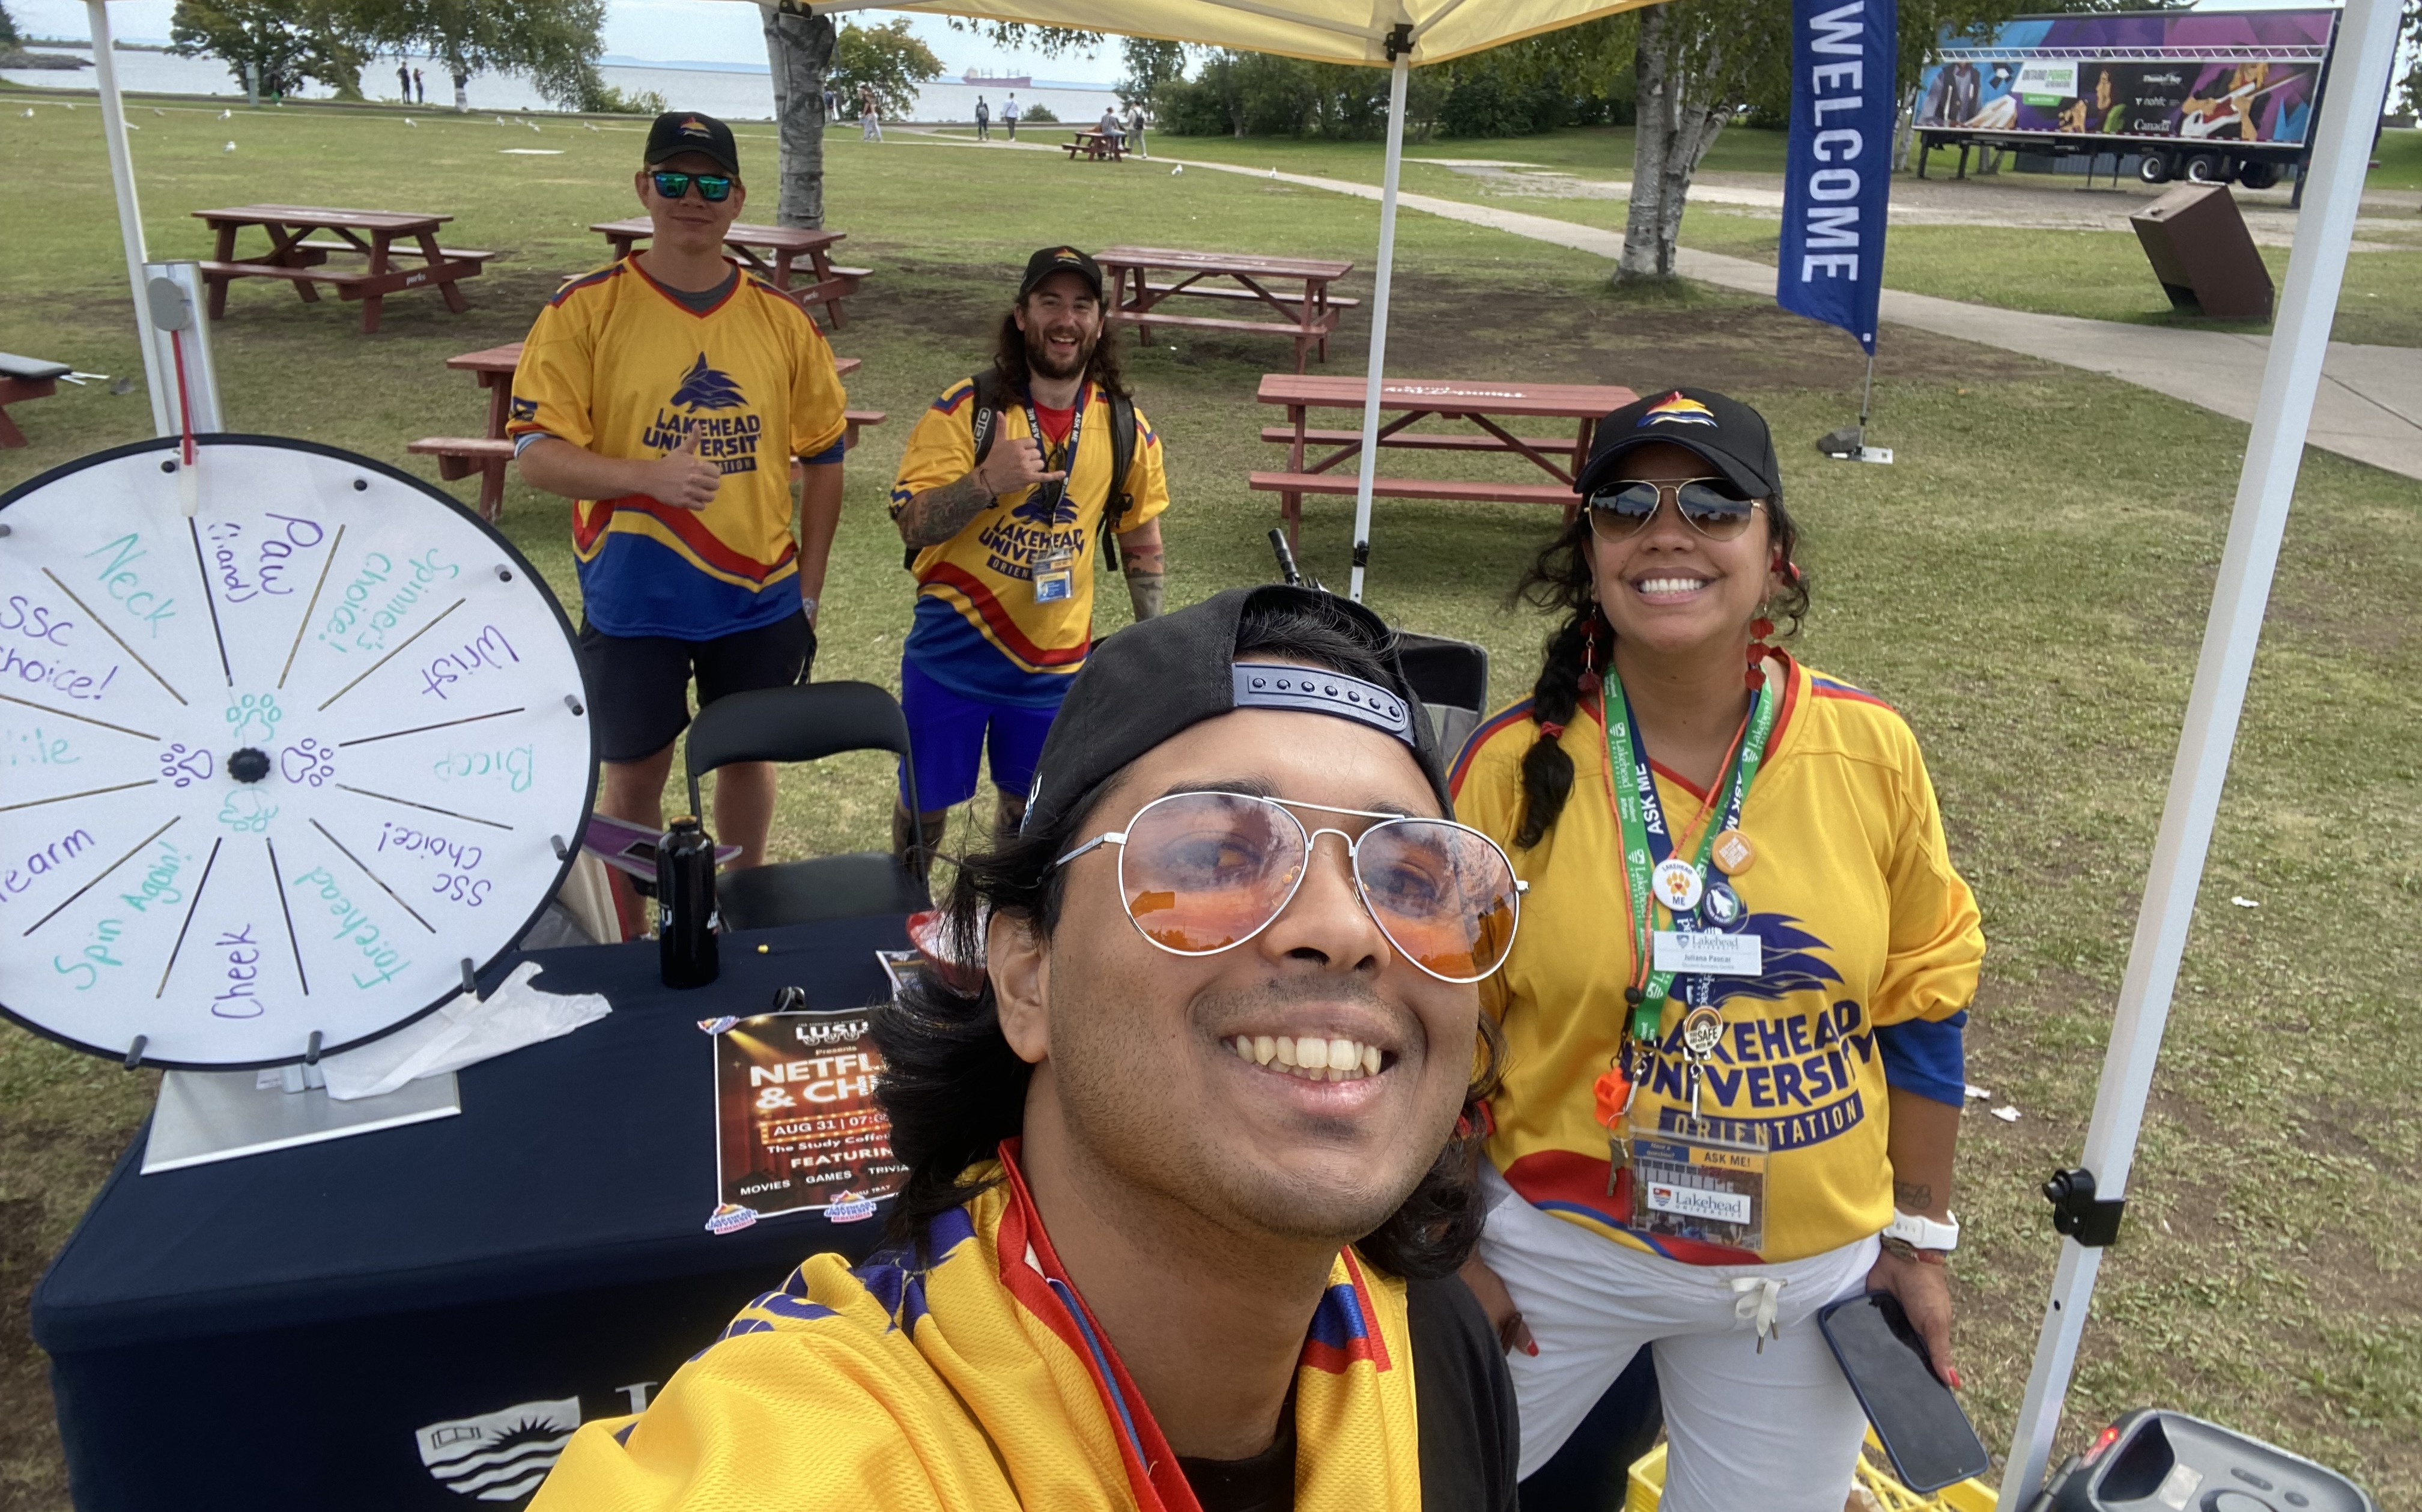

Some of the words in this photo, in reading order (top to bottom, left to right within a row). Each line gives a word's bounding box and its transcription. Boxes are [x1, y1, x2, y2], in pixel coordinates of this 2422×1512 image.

[2134, 118, 2171, 132] Canada
[1802, 1, 1864, 283] WELCOME
[655, 407, 762, 437] LAKEHEAD
[1026, 408, 1036, 421] ME
[1030, 421, 1041, 439] ASK
[1073, 411, 1081, 430] ASK
[642, 426, 762, 458] UNIERSIT
[1070, 430, 1079, 443] ME
[258, 512, 324, 596] Paw
[84, 532, 178, 639] Neck
[356, 547, 460, 651] Spinner's
[318, 551, 392, 654] Choice!
[0, 595, 74, 647] SSC
[0, 645, 118, 700] hoice!
[421, 624, 520, 700] Wrist
[1747, 699, 1770, 748] Lakehead
[1616, 738, 1633, 789] Lakehead
[1635, 763, 1652, 792] ME
[1640, 794, 1665, 835] ASK
[1725, 815, 1739, 831] M
[377, 822, 483, 870] Choice!
[1662, 863, 1693, 876] LAKEHEAD
[432, 873, 492, 907] SSC
[1672, 896, 1686, 906] ME
[53, 918, 124, 991] Spin
[120, 839, 193, 912] Again!
[293, 866, 411, 990] Forehead
[1692, 935, 1738, 948] Lakehead
[210, 923, 264, 1020] Cheek
[1698, 1027, 1718, 1042] SAFE
[815, 1045, 858, 1057] Presents
[750, 1052, 881, 1088] NETFL
[754, 1087, 797, 1110] &
[803, 1073, 879, 1104] CHI
[773, 1122, 812, 1137] AUG
[816, 1119, 836, 1131] 31
[1673, 1098, 1858, 1150] ORIENTATION
[766, 1143, 794, 1155] The
[798, 1139, 840, 1153] Study
[791, 1147, 894, 1169] FEATURIN
[1704, 1151, 1726, 1165] ASK
[1729, 1153, 1751, 1168] ME!
[740, 1179, 791, 1196] MOVIES
[805, 1170, 852, 1185] GAMES
[867, 1164, 911, 1175] TRIVIA
[1675, 1191, 1741, 1214] Lakehead
[1675, 1203, 1742, 1219] UNIVERSITY
